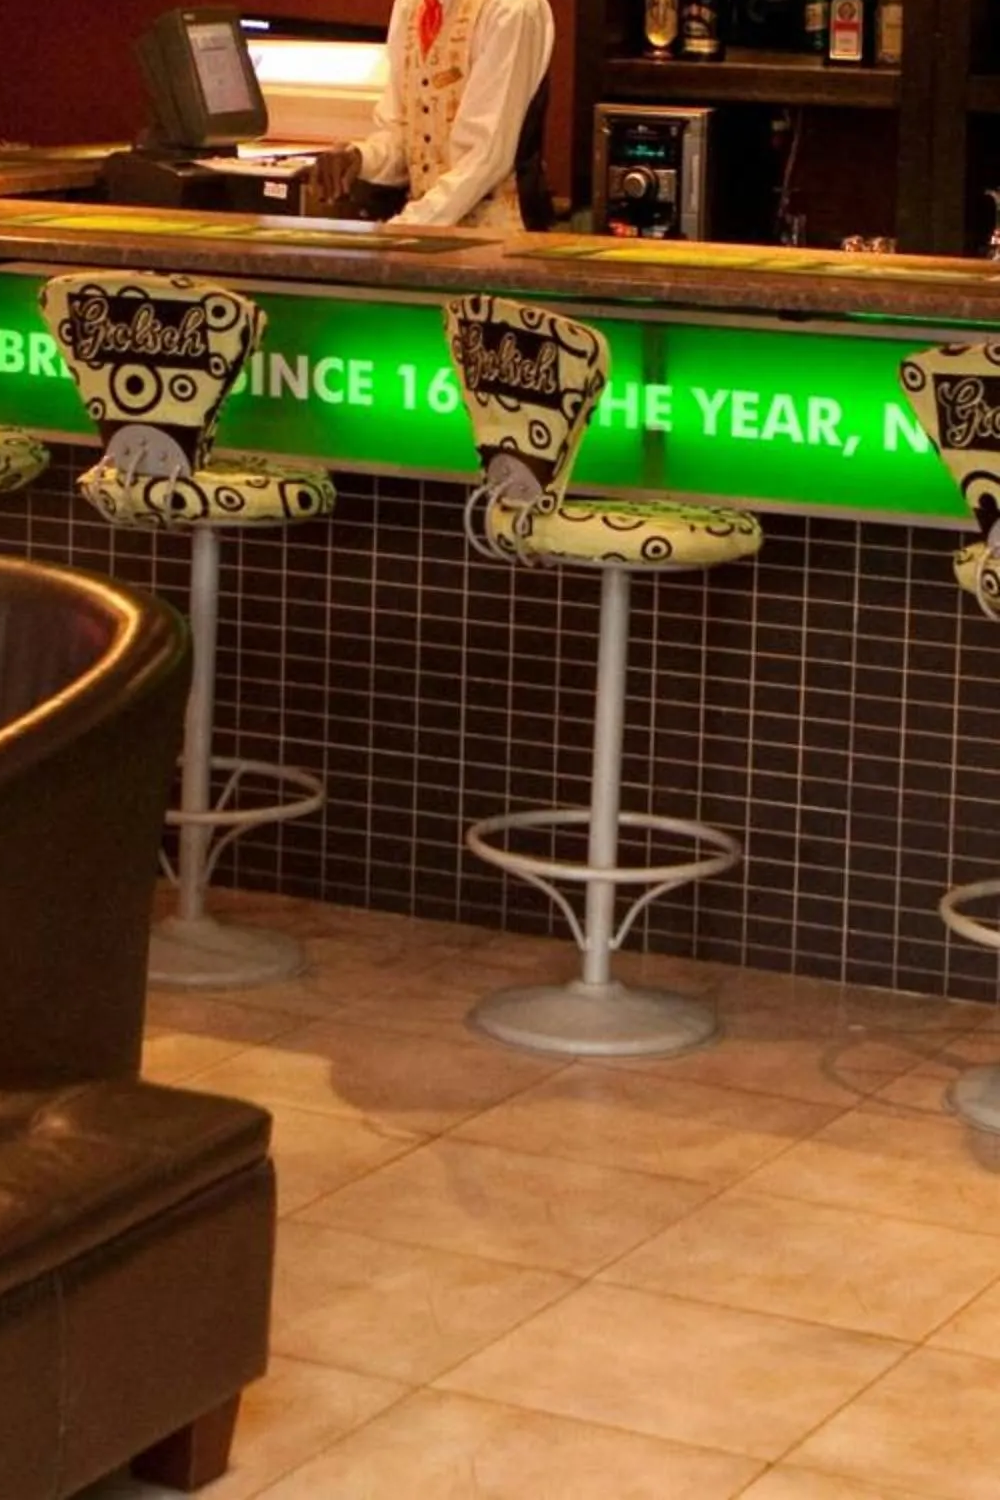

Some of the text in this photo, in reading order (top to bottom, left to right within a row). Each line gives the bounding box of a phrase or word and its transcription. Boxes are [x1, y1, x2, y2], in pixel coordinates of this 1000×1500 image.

[72, 299, 207, 358] Grolsch
[461, 323, 557, 394] Grolsch
[600, 381, 673, 432] HE
[690, 386, 862, 457] YEAR,
